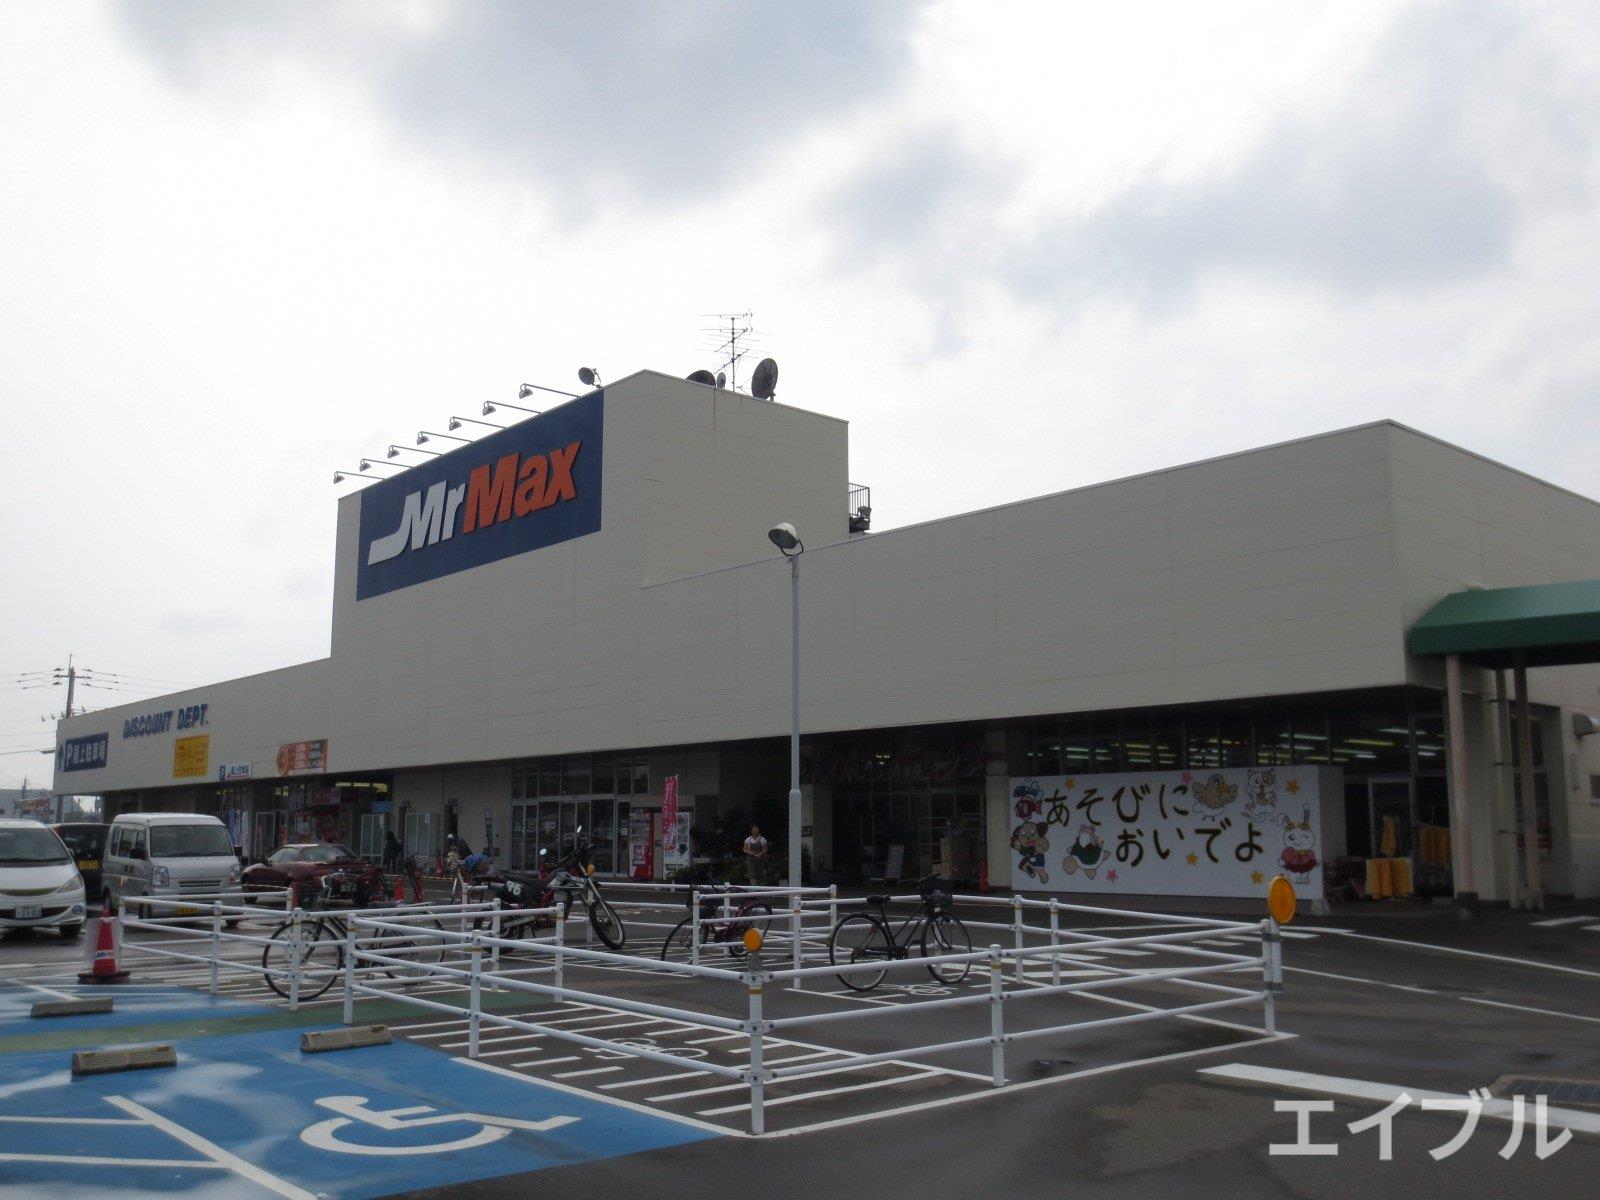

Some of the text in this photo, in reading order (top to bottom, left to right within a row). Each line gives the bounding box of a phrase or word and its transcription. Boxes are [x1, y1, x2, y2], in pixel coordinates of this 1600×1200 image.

[368, 441, 581, 566] MrMax
[123, 711, 174, 738] DISCOUNT
[1044, 783, 1189, 827] あそびに
[1115, 817, 1263, 867] おいでよ
